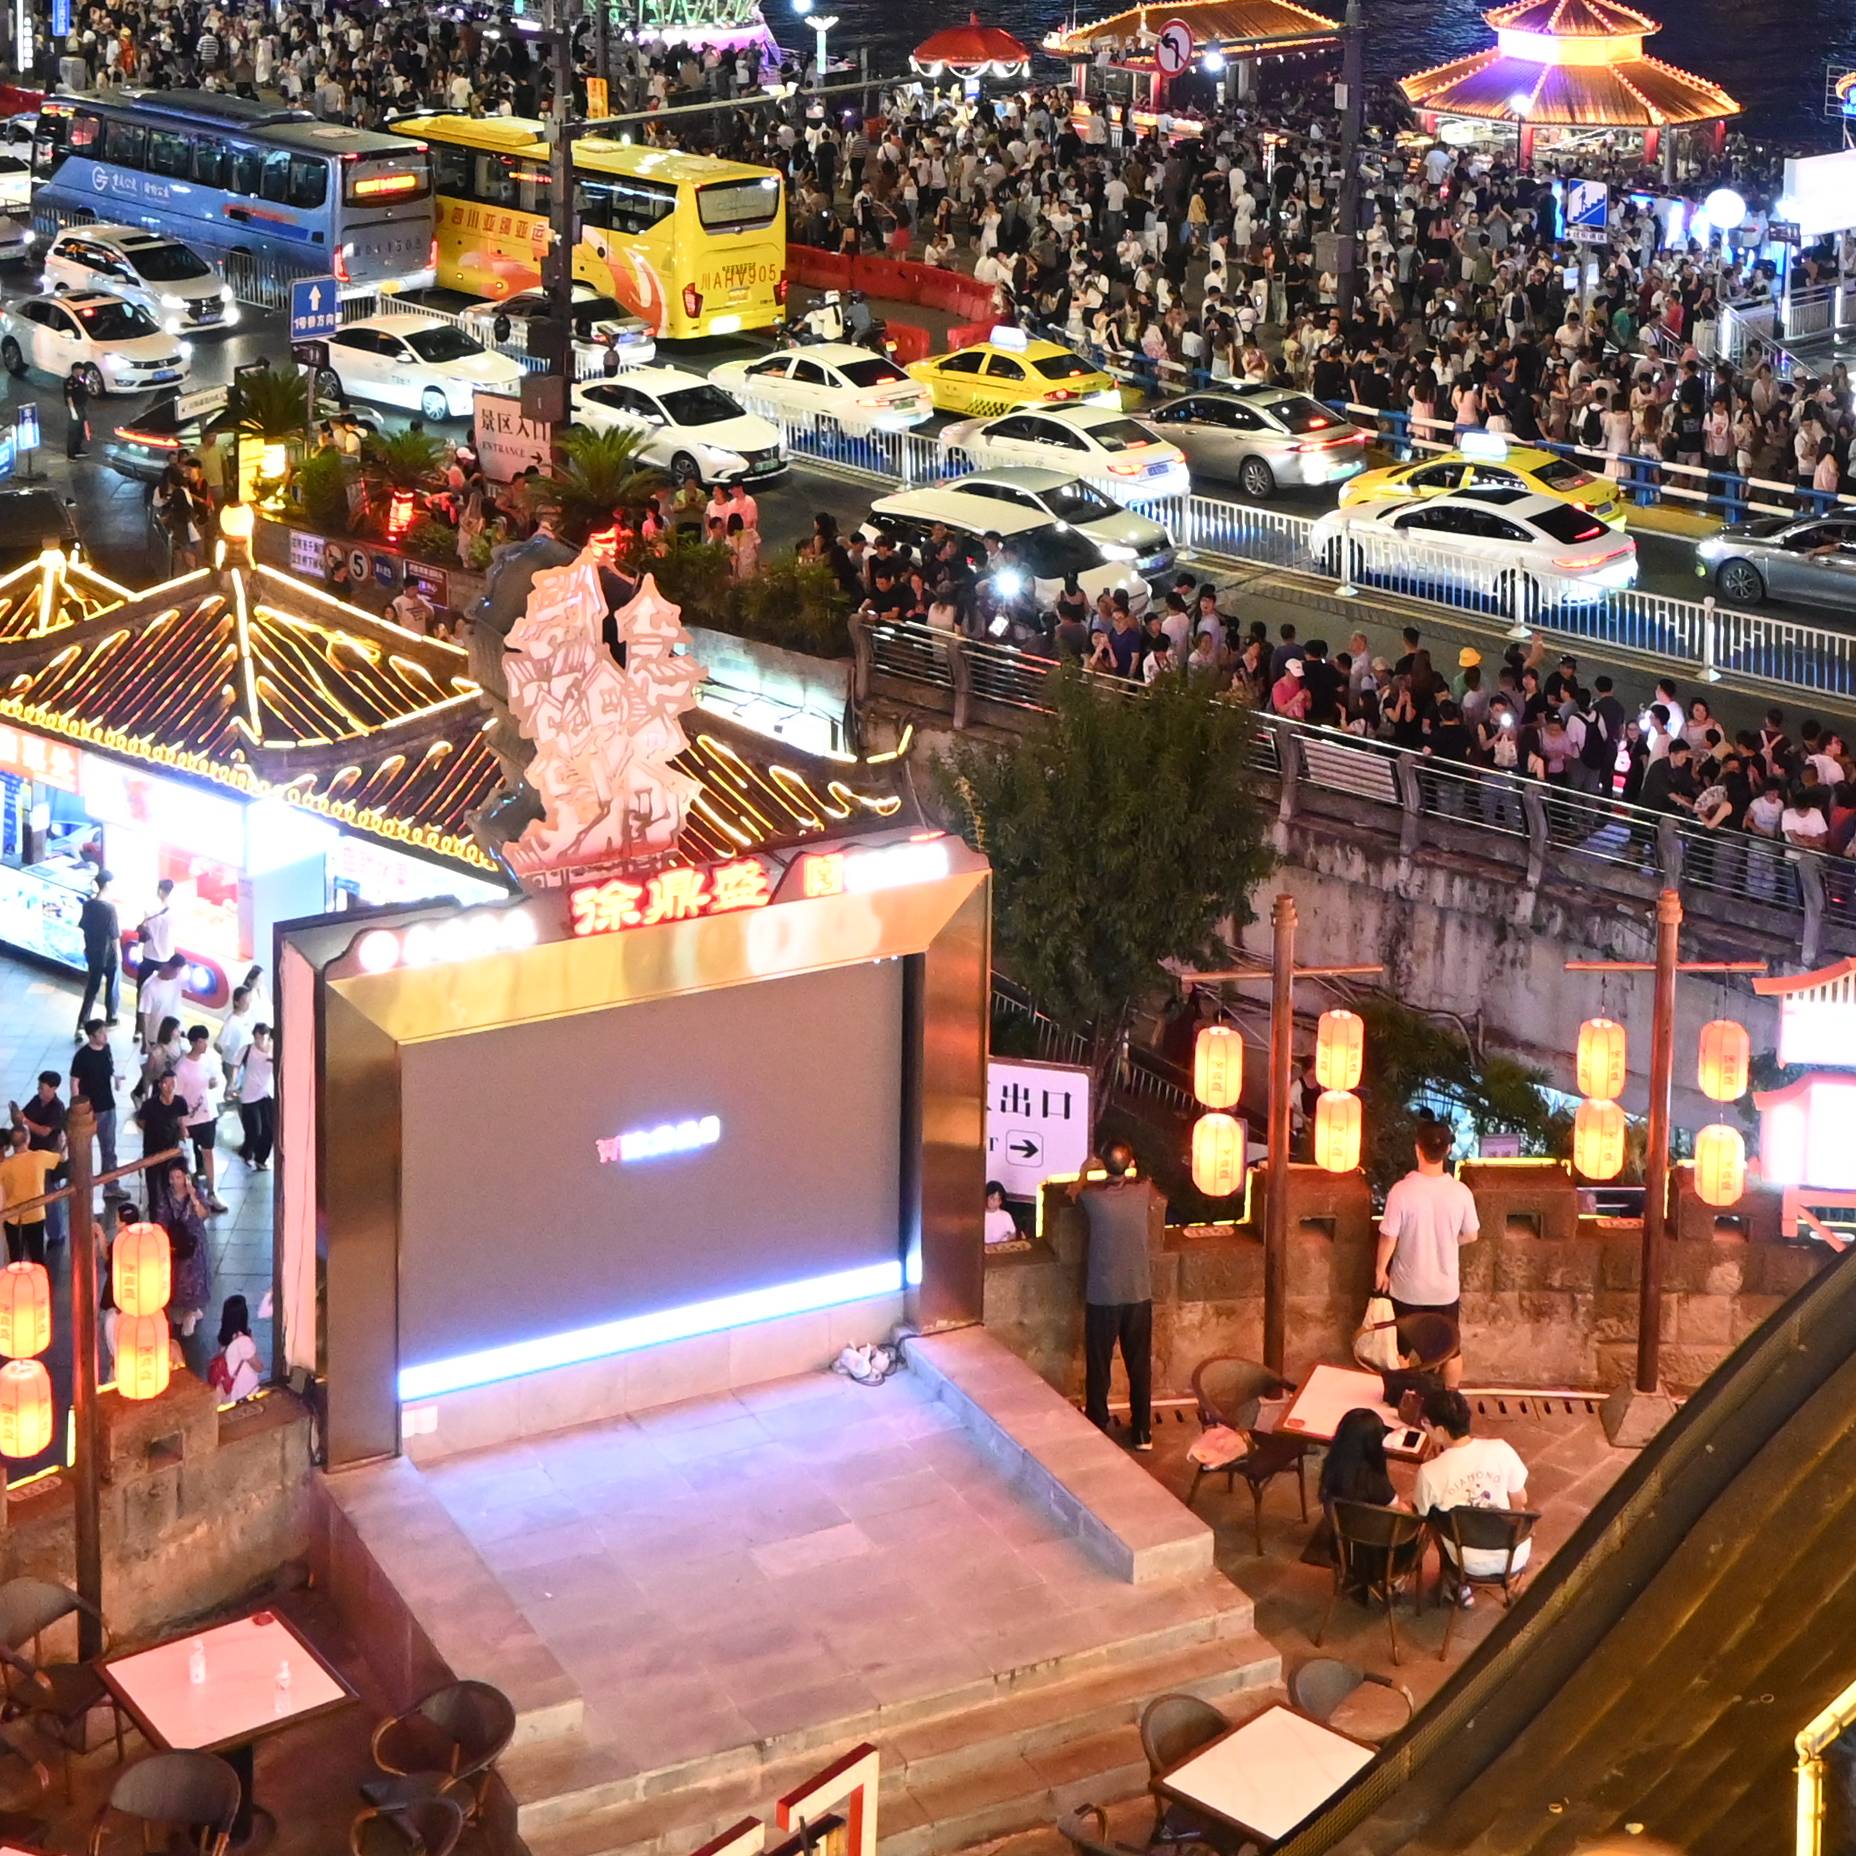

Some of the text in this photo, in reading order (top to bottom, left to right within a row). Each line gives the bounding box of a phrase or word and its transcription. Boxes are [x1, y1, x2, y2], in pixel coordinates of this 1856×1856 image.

[701, 264, 776, 291] 川AHV905
[481, 408, 548, 442] 景区入口
[481, 441, 525, 458] ENTRANCE
[353, 554, 364, 578] 5
[571, 856, 771, 937] 徐鼎盛
[986, 1080, 1072, 1120] 出口
[1448, 1471, 1501, 1495] DIAMOND
